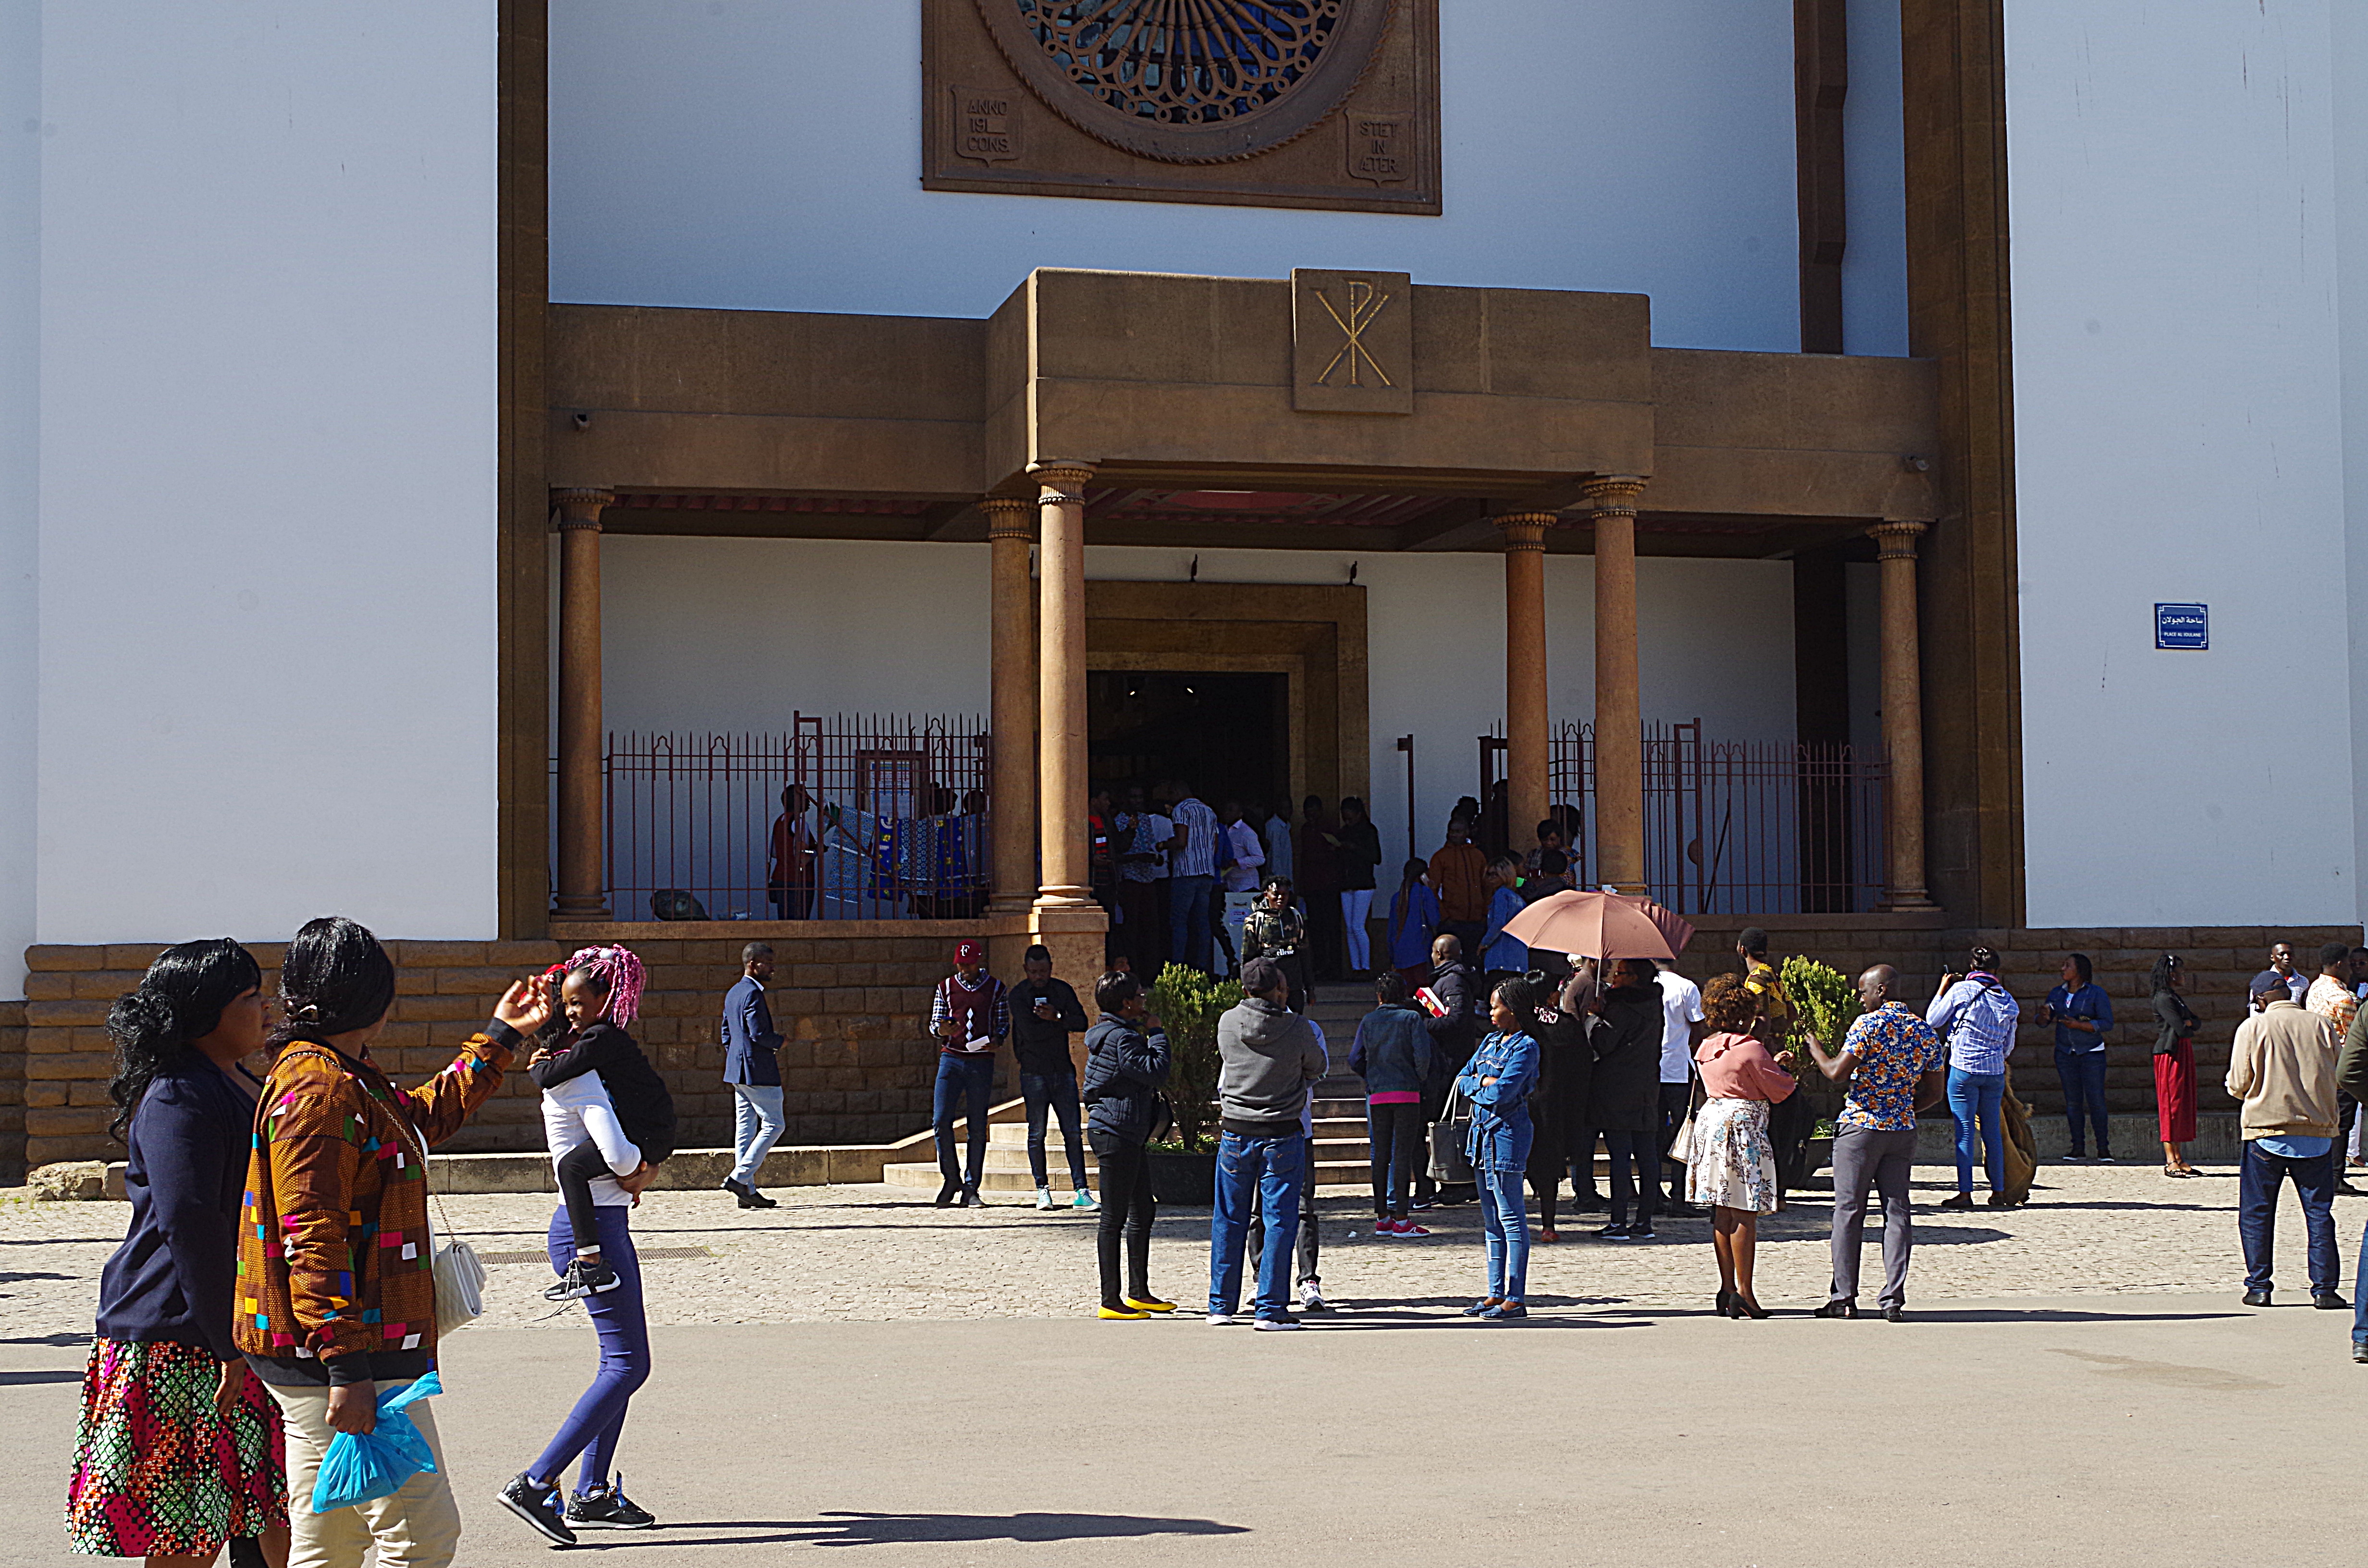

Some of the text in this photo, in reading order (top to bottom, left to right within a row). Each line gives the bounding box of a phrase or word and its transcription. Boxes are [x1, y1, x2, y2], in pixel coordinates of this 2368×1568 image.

[968, 99, 1007, 115] ANNO
[1360, 122, 1398, 137] STET
[1372, 140, 1386, 154] IN
